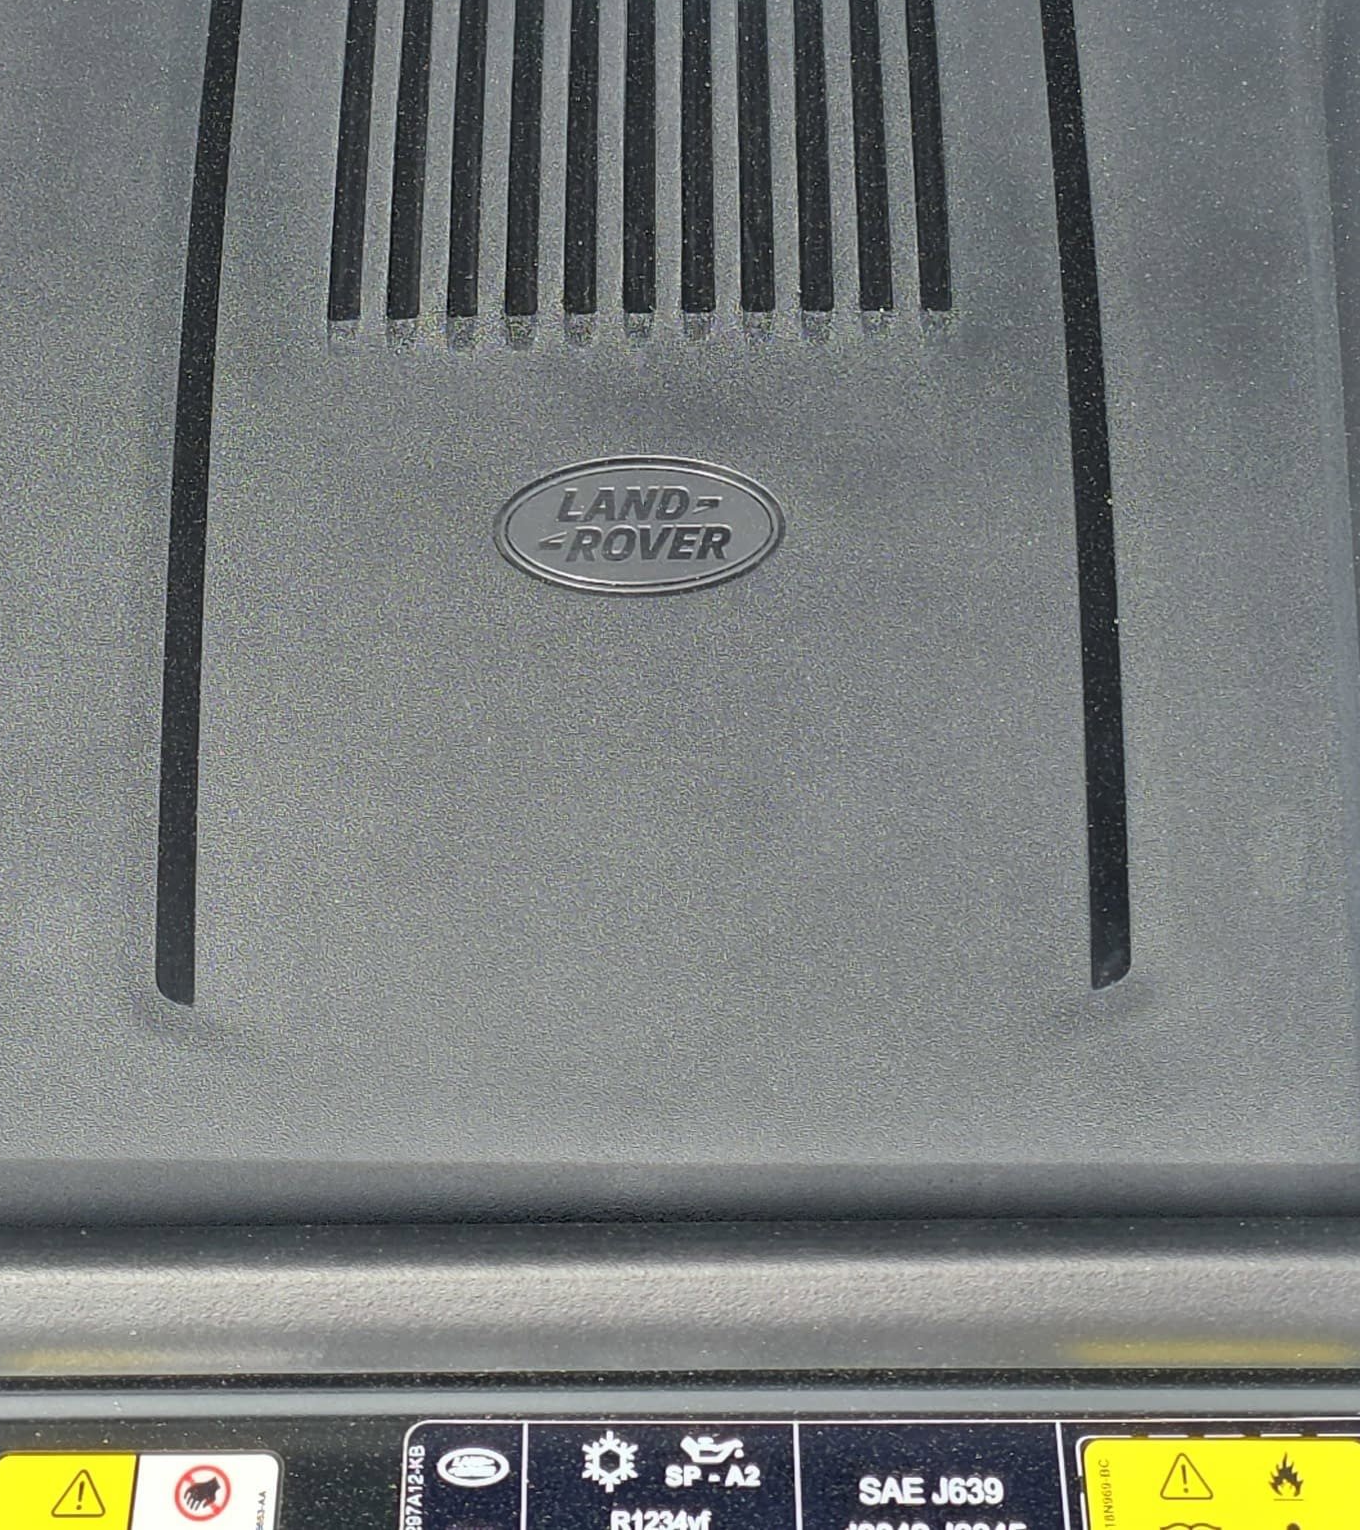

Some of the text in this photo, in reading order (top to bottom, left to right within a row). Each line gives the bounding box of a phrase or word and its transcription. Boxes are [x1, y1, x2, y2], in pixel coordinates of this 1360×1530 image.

[556, 485, 690, 522] LAND
[565, 524, 733, 562] ROVER
[664, 1464, 703, 1488] SP
[724, 1464, 762, 1488] A2
[858, 1476, 1005, 1505] SAE J639
